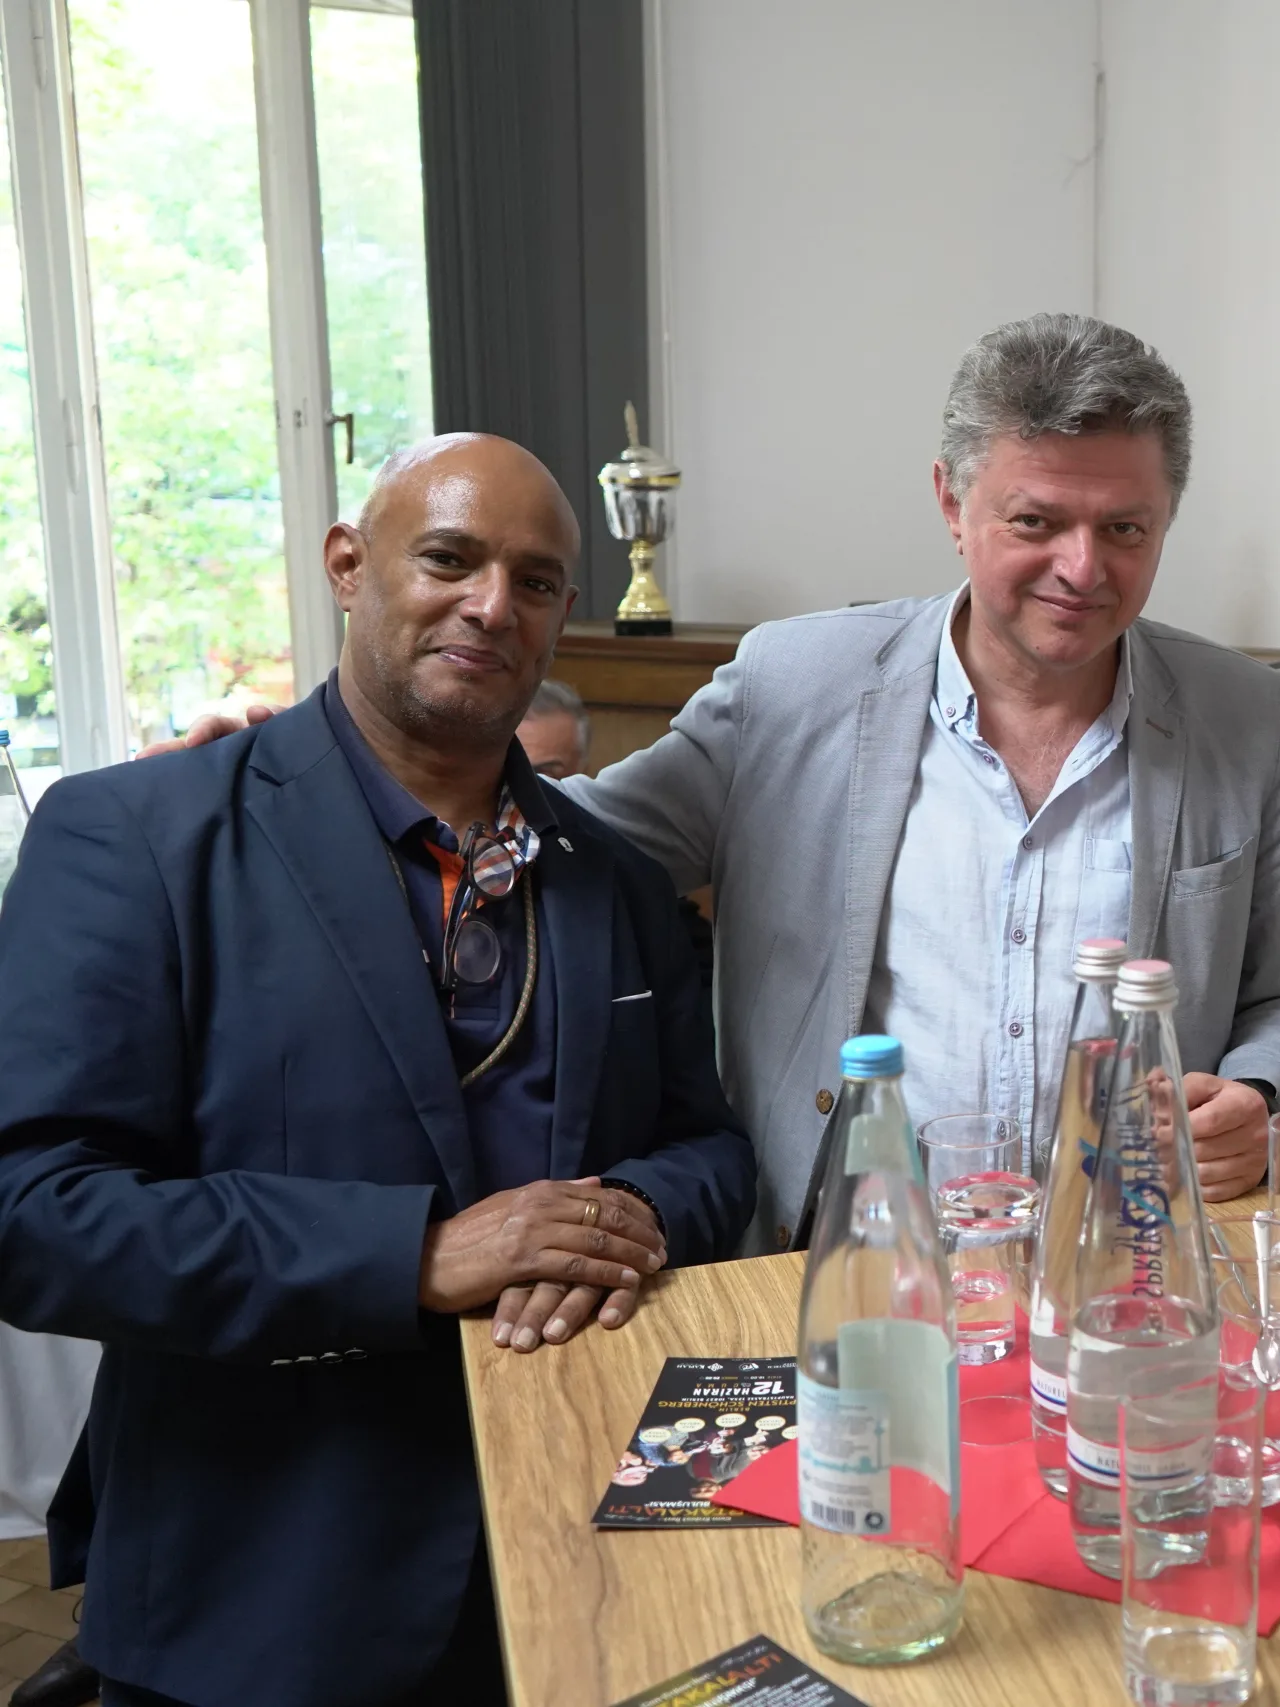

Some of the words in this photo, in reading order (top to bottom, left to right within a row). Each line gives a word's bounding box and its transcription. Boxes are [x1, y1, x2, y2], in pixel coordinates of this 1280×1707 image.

[692, 1388, 750, 1397] HAZİRAN
[751, 1380, 785, 1396] 12
[657, 1400, 745, 1409] SCHÖNEBERG
[748, 1399, 797, 1407] PTISTEN
